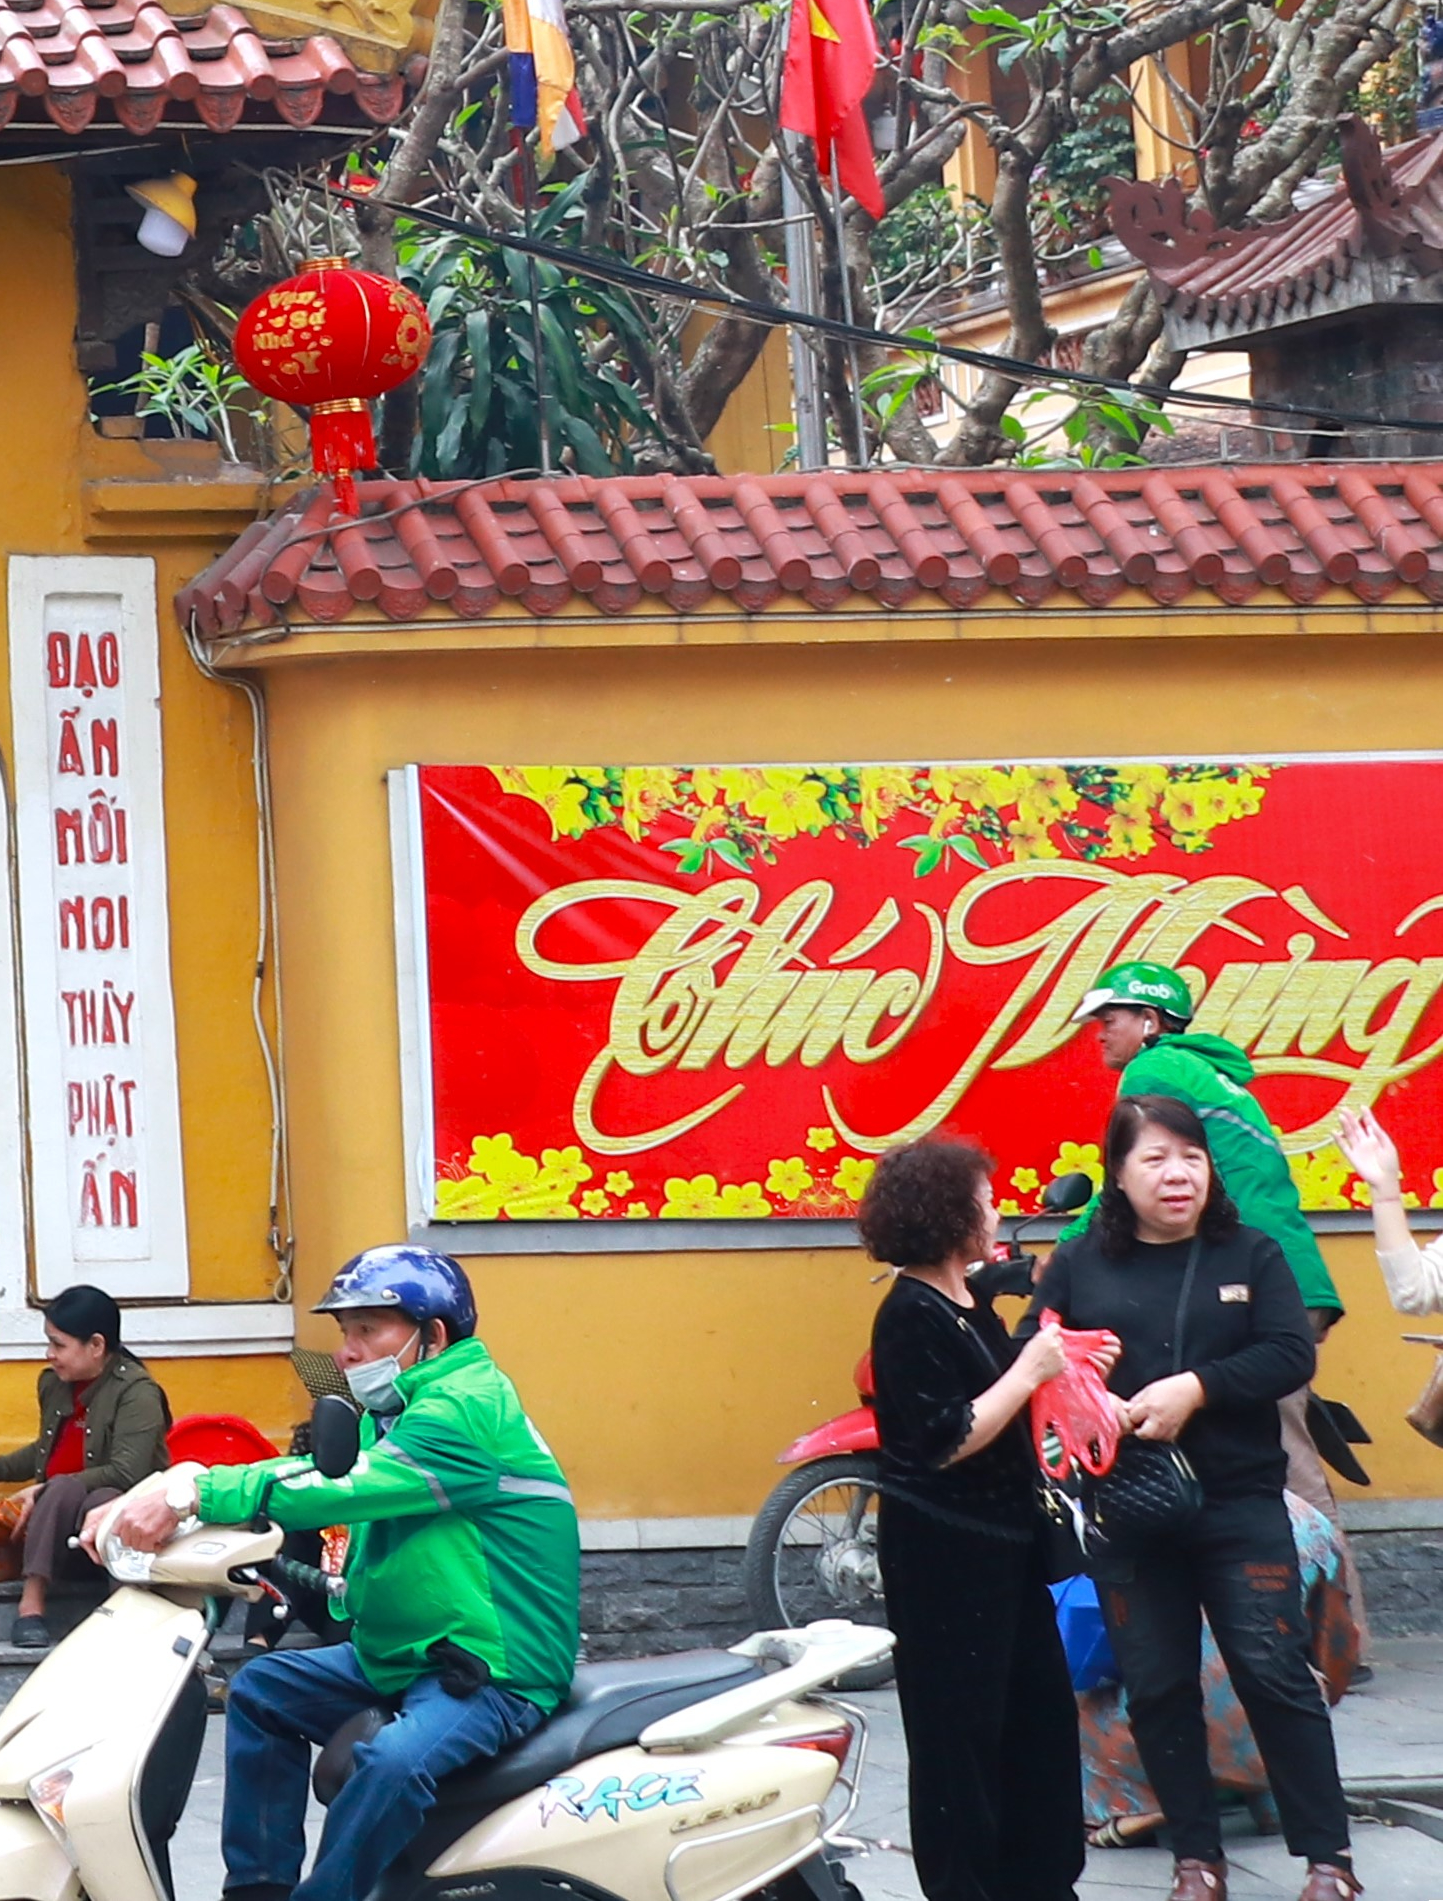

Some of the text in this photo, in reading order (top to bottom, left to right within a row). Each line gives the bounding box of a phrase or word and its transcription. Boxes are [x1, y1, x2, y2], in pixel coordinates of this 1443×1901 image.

[46, 630, 121, 700] ĐẠO
[54, 788, 130, 866] NỐI
[58, 894, 131, 952] NOI
[513, 877, 945, 1154] Chúc
[1127, 980, 1171, 1000] Grab
[67, 1072, 138, 1148] PHẬT
[537, 1767, 708, 1829] RACE
